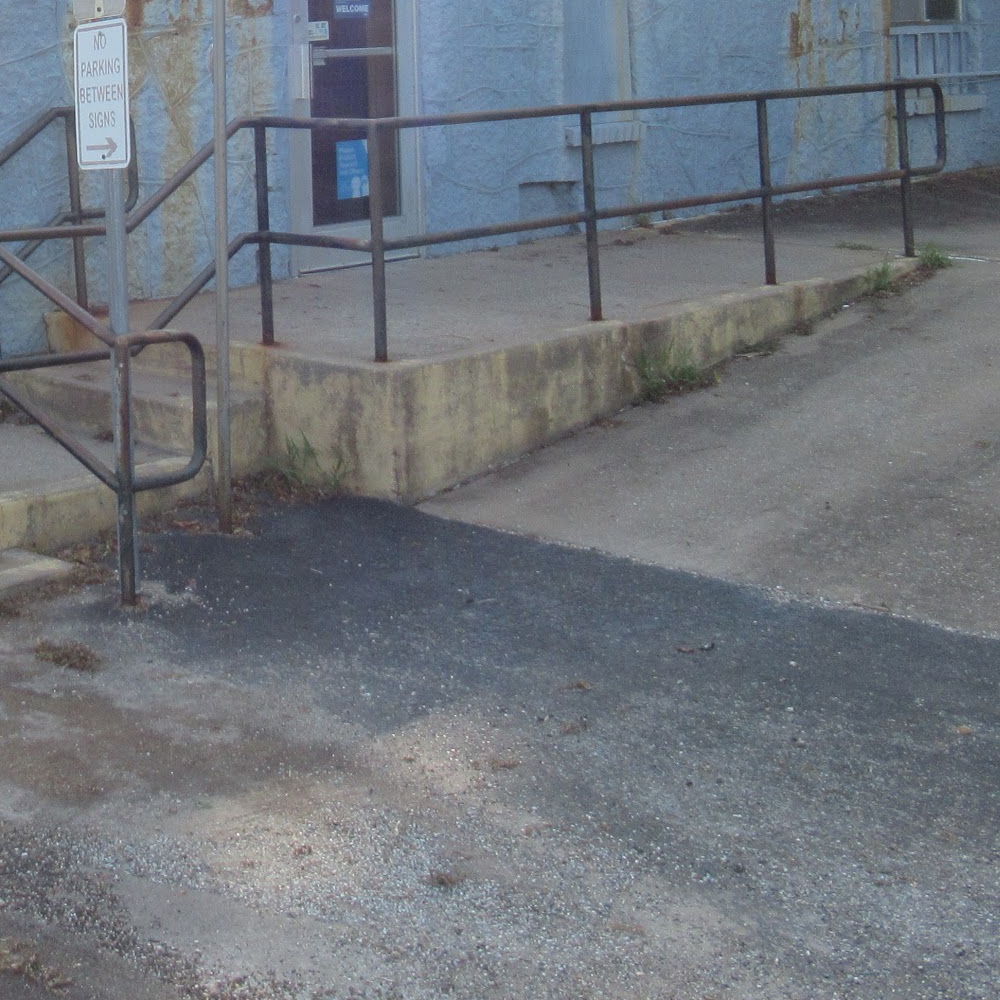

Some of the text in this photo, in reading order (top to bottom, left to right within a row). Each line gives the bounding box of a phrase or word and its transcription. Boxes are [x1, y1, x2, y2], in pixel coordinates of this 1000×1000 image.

[336, 4, 369, 13] WELCOME
[93, 33, 107, 51] NO
[80, 57, 121, 78] PARKING
[79, 83, 123, 104] BETWEEN
[88, 111, 116, 129] SIGNS
